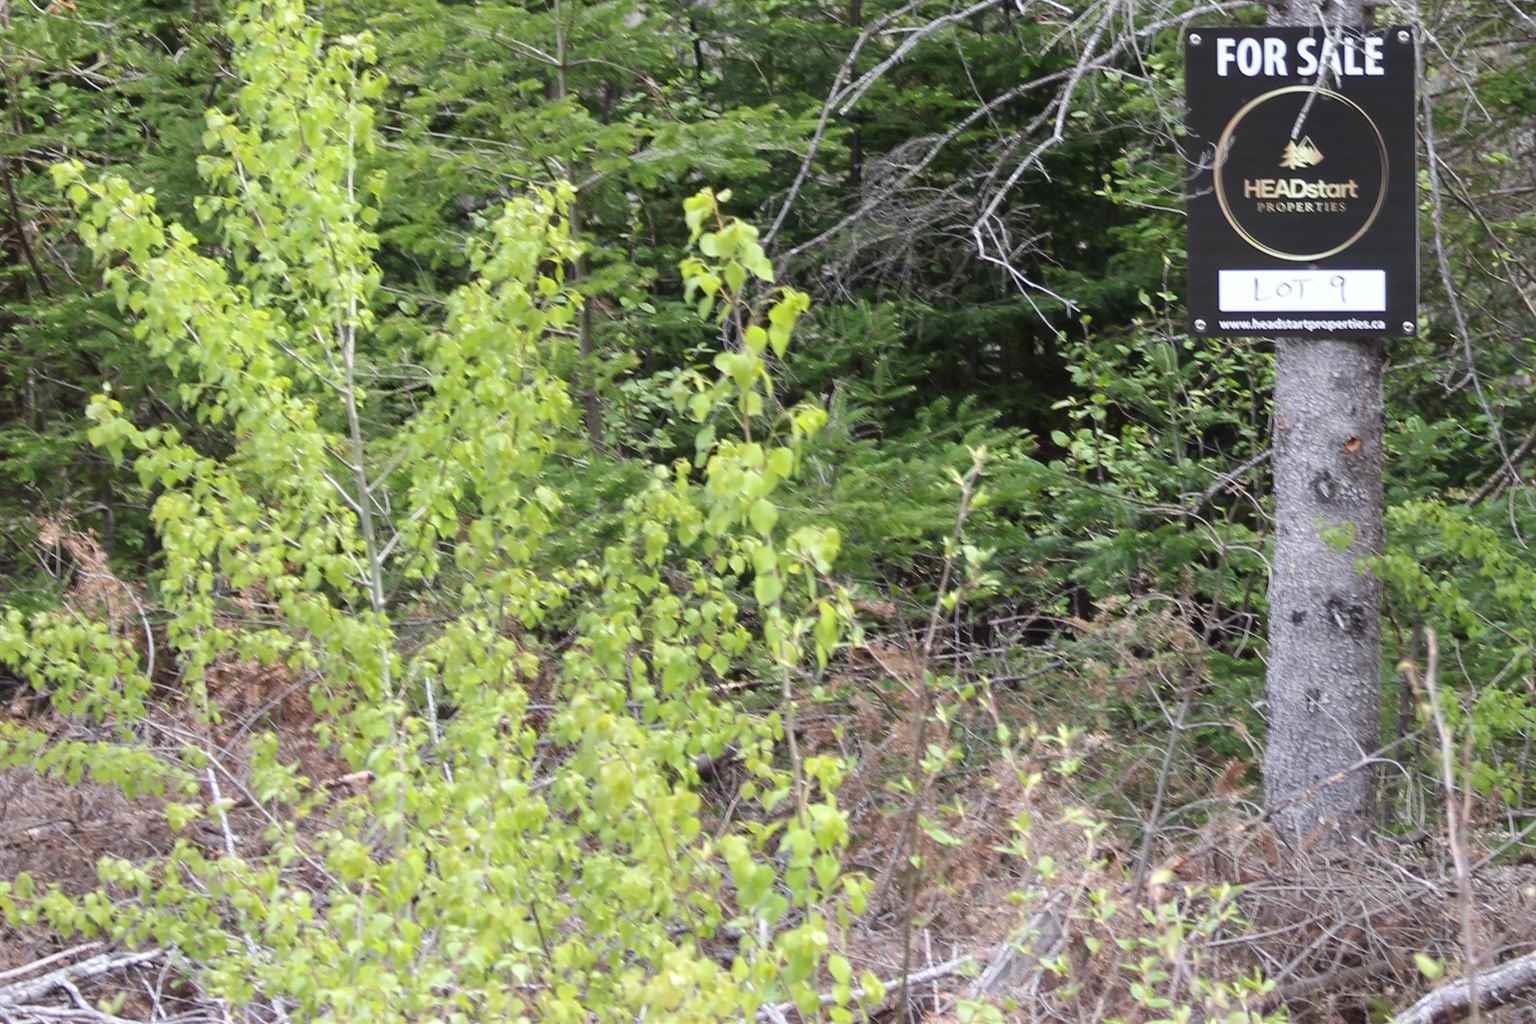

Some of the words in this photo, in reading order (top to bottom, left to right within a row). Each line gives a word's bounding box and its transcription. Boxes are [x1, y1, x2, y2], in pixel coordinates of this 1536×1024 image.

[1216, 37, 1288, 77] FOR
[1296, 36, 1385, 76] SALE
[1243, 178, 1360, 199] HEADstart
[1256, 201, 1347, 213] PROPERTIES
[1253, 277, 1312, 301] LOT
[1330, 274, 1346, 304] 9
[1218, 317, 1386, 332] www.headstartproperties.ca
